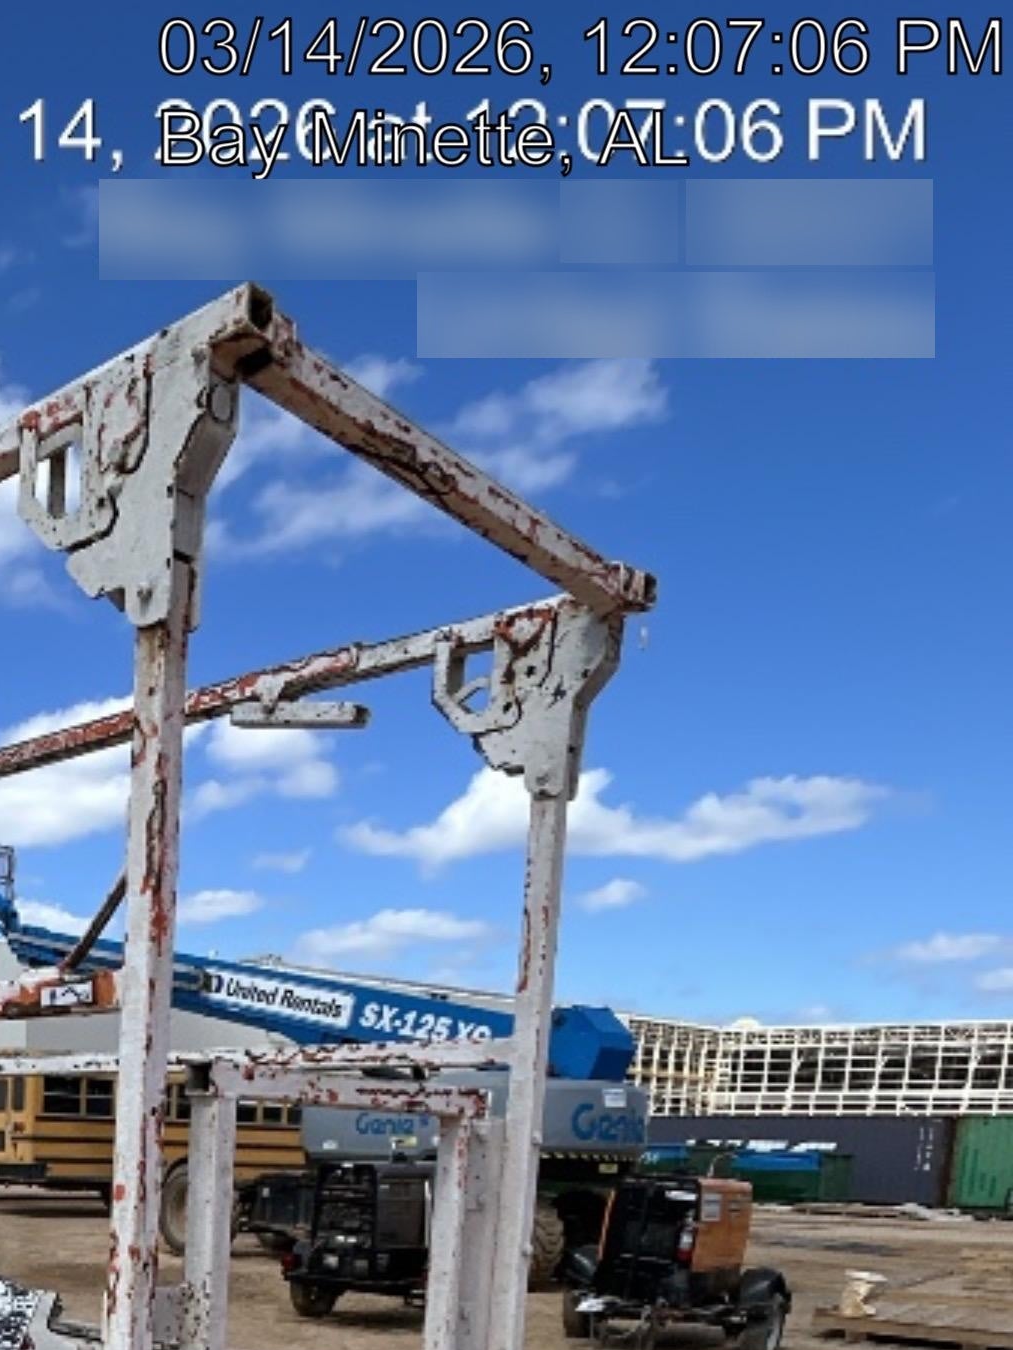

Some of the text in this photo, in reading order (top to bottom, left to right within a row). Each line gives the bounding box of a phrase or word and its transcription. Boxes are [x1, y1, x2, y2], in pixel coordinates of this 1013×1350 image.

[226, 977, 343, 1018] United Rentals
[359, 1001, 453, 1042] SX-125
[355, 1111, 414, 1135] Genie
